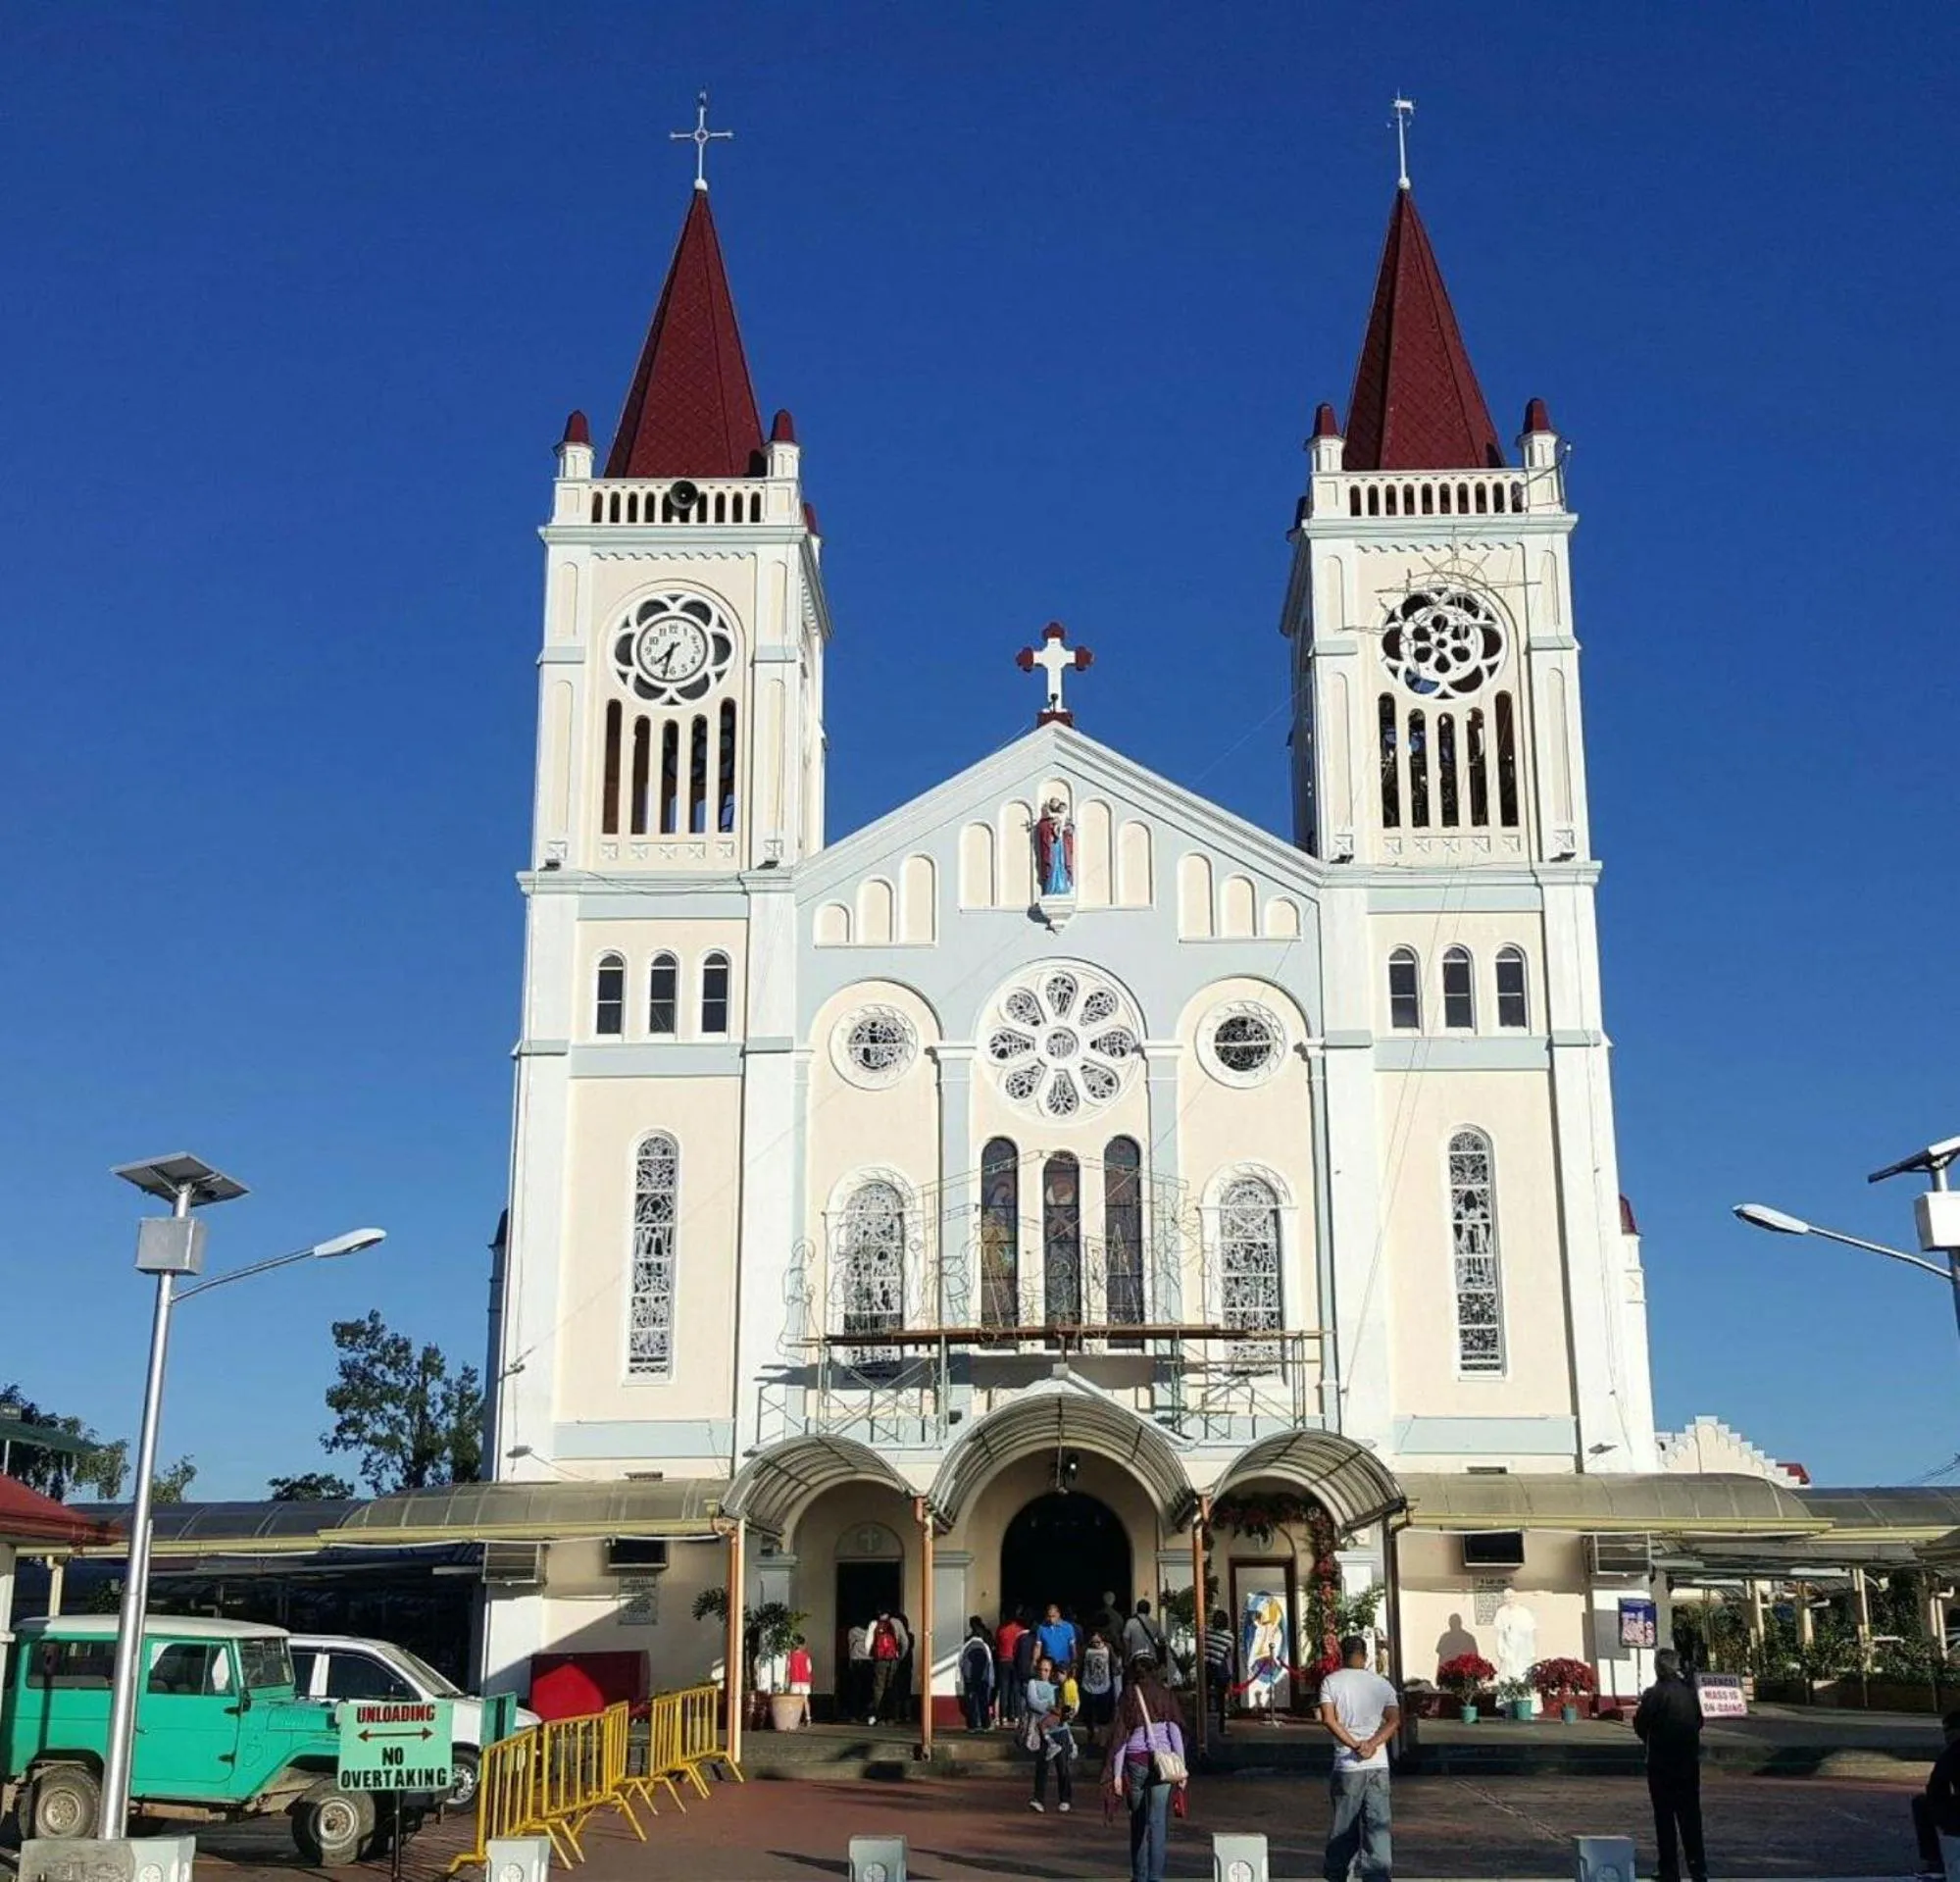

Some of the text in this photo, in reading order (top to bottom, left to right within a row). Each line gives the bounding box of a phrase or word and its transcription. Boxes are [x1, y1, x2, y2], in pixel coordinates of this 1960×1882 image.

[649, 636, 658, 645] 10
[1704, 1690, 1738, 1700] MASS IS
[357, 1704, 435, 1723] UNLOADING
[381, 1747, 404, 1766] NO
[340, 1767, 447, 1788] OVERTAKING
